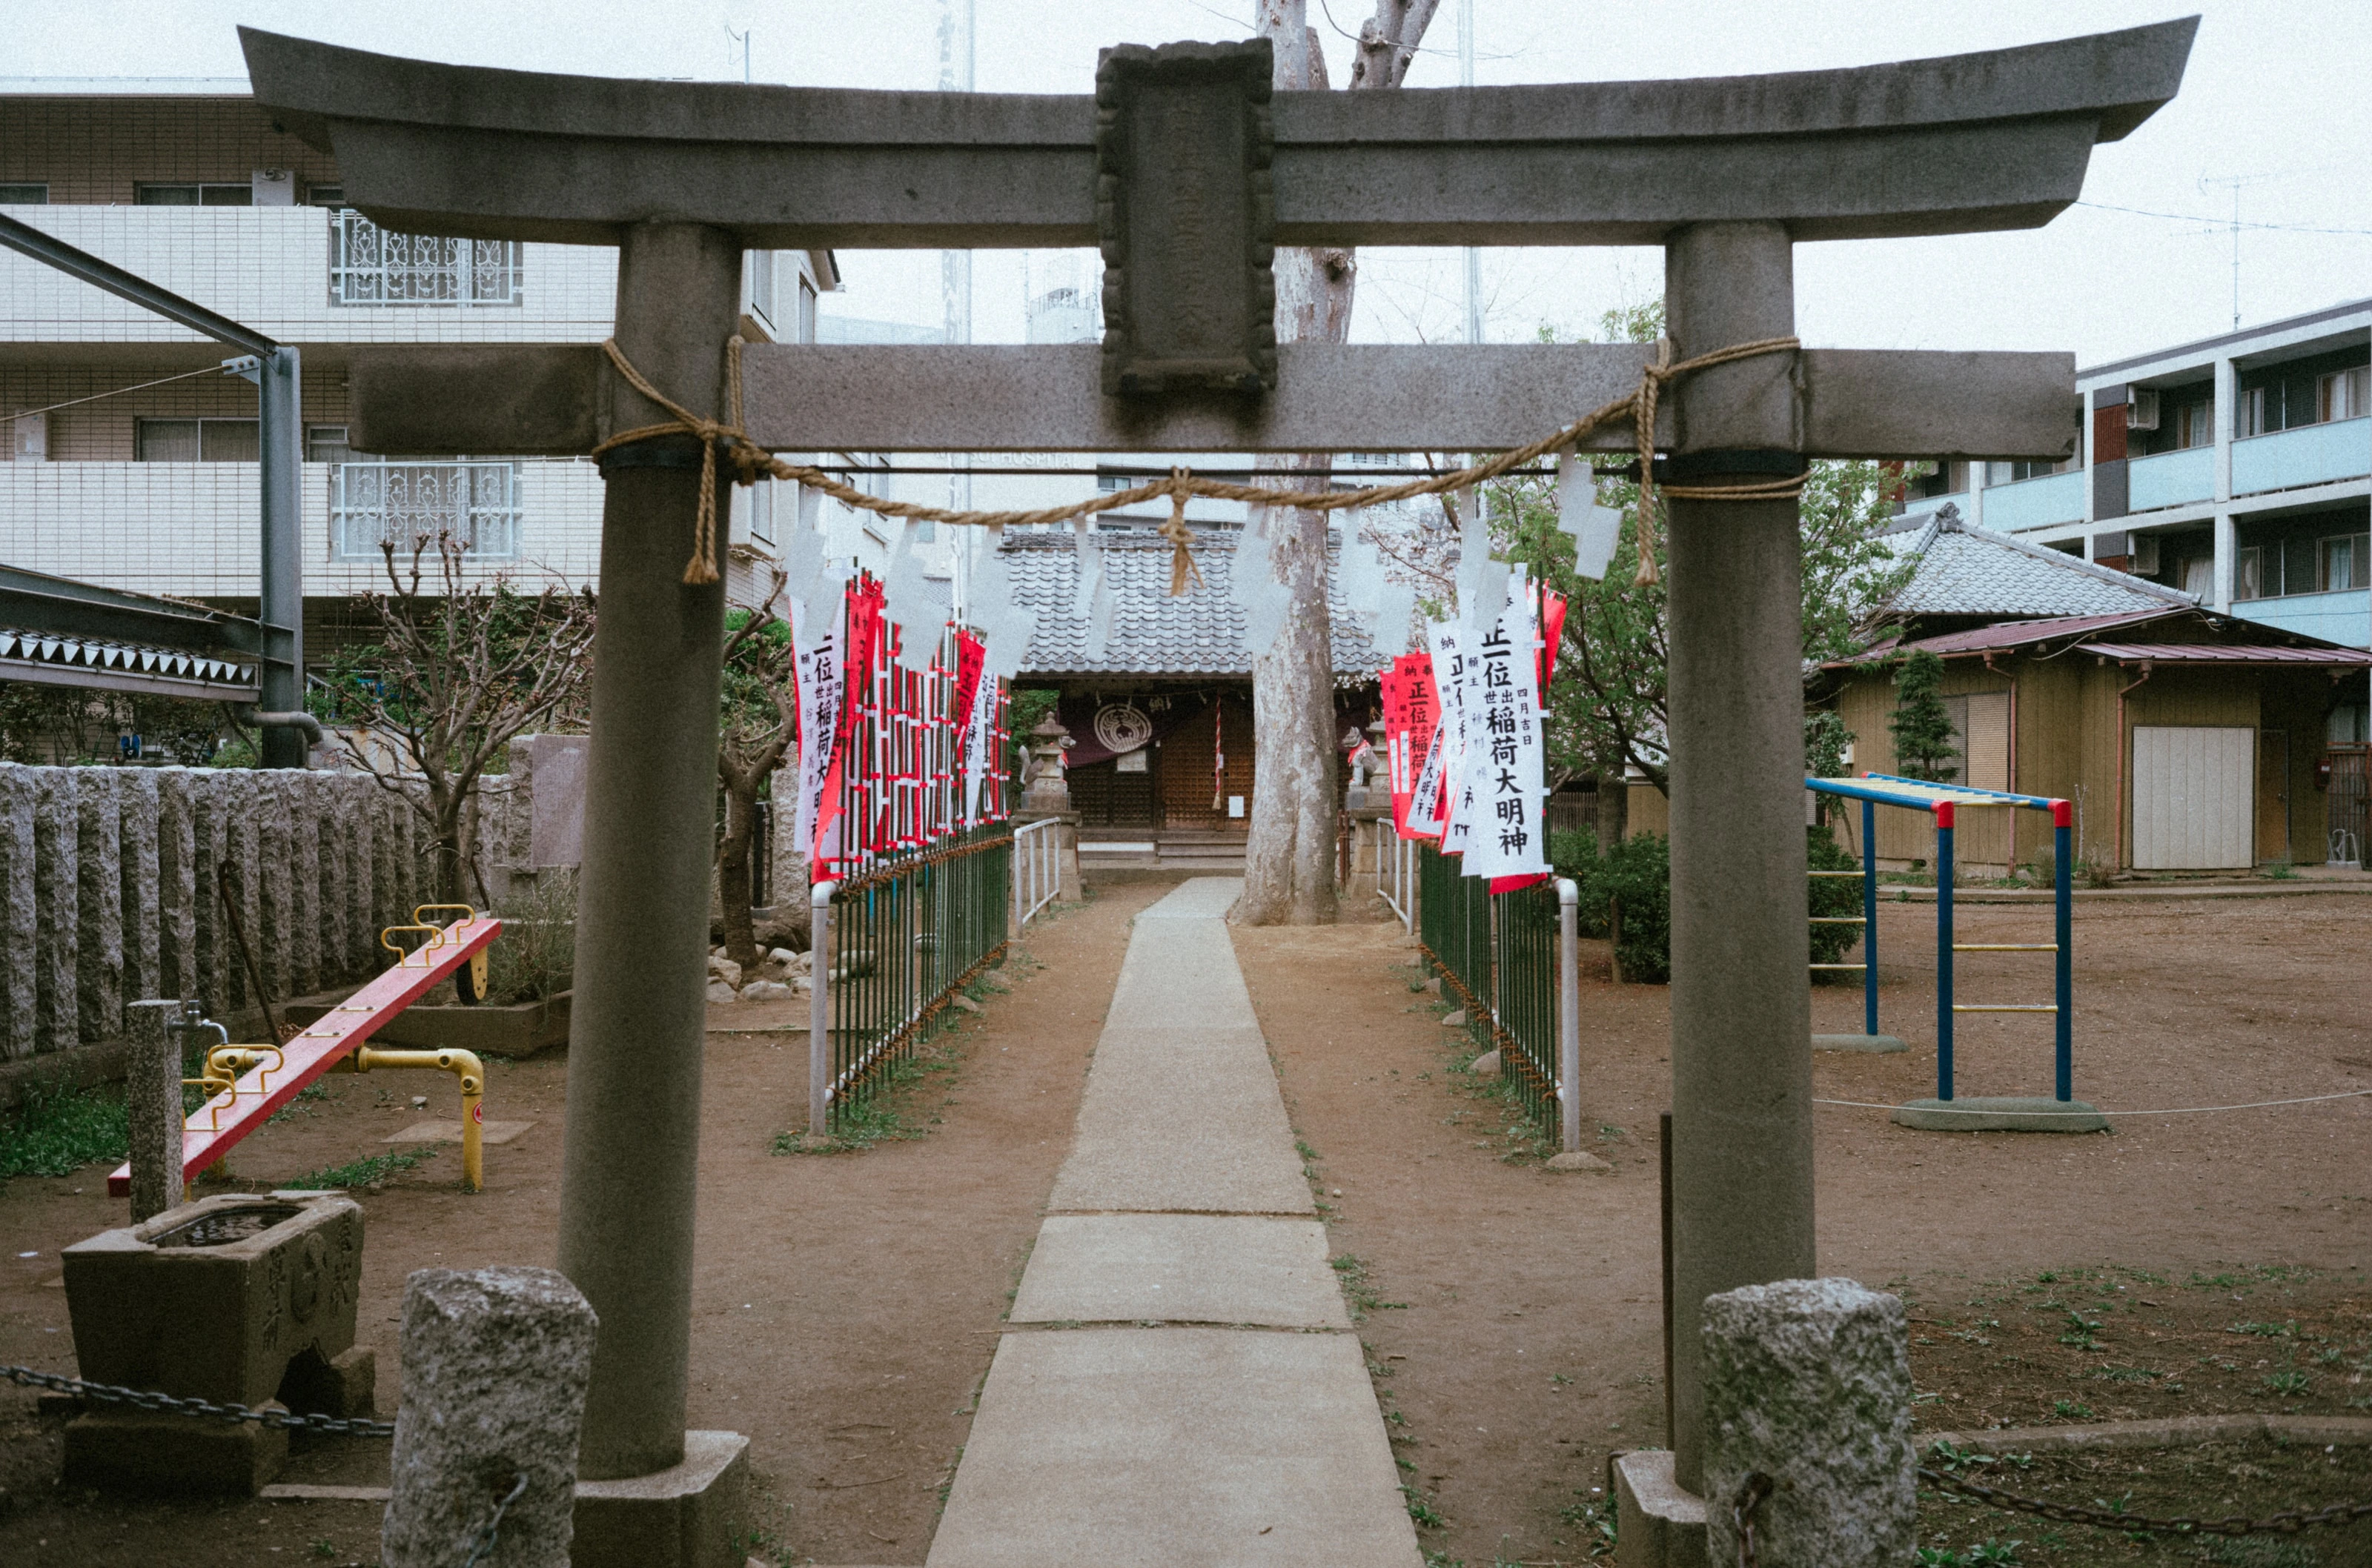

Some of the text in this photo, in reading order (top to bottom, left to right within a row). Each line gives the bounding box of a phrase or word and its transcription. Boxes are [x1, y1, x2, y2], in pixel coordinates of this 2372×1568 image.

[1468, 657, 1479, 687] 願主
[1517, 688, 1532, 745] 四月吉日
